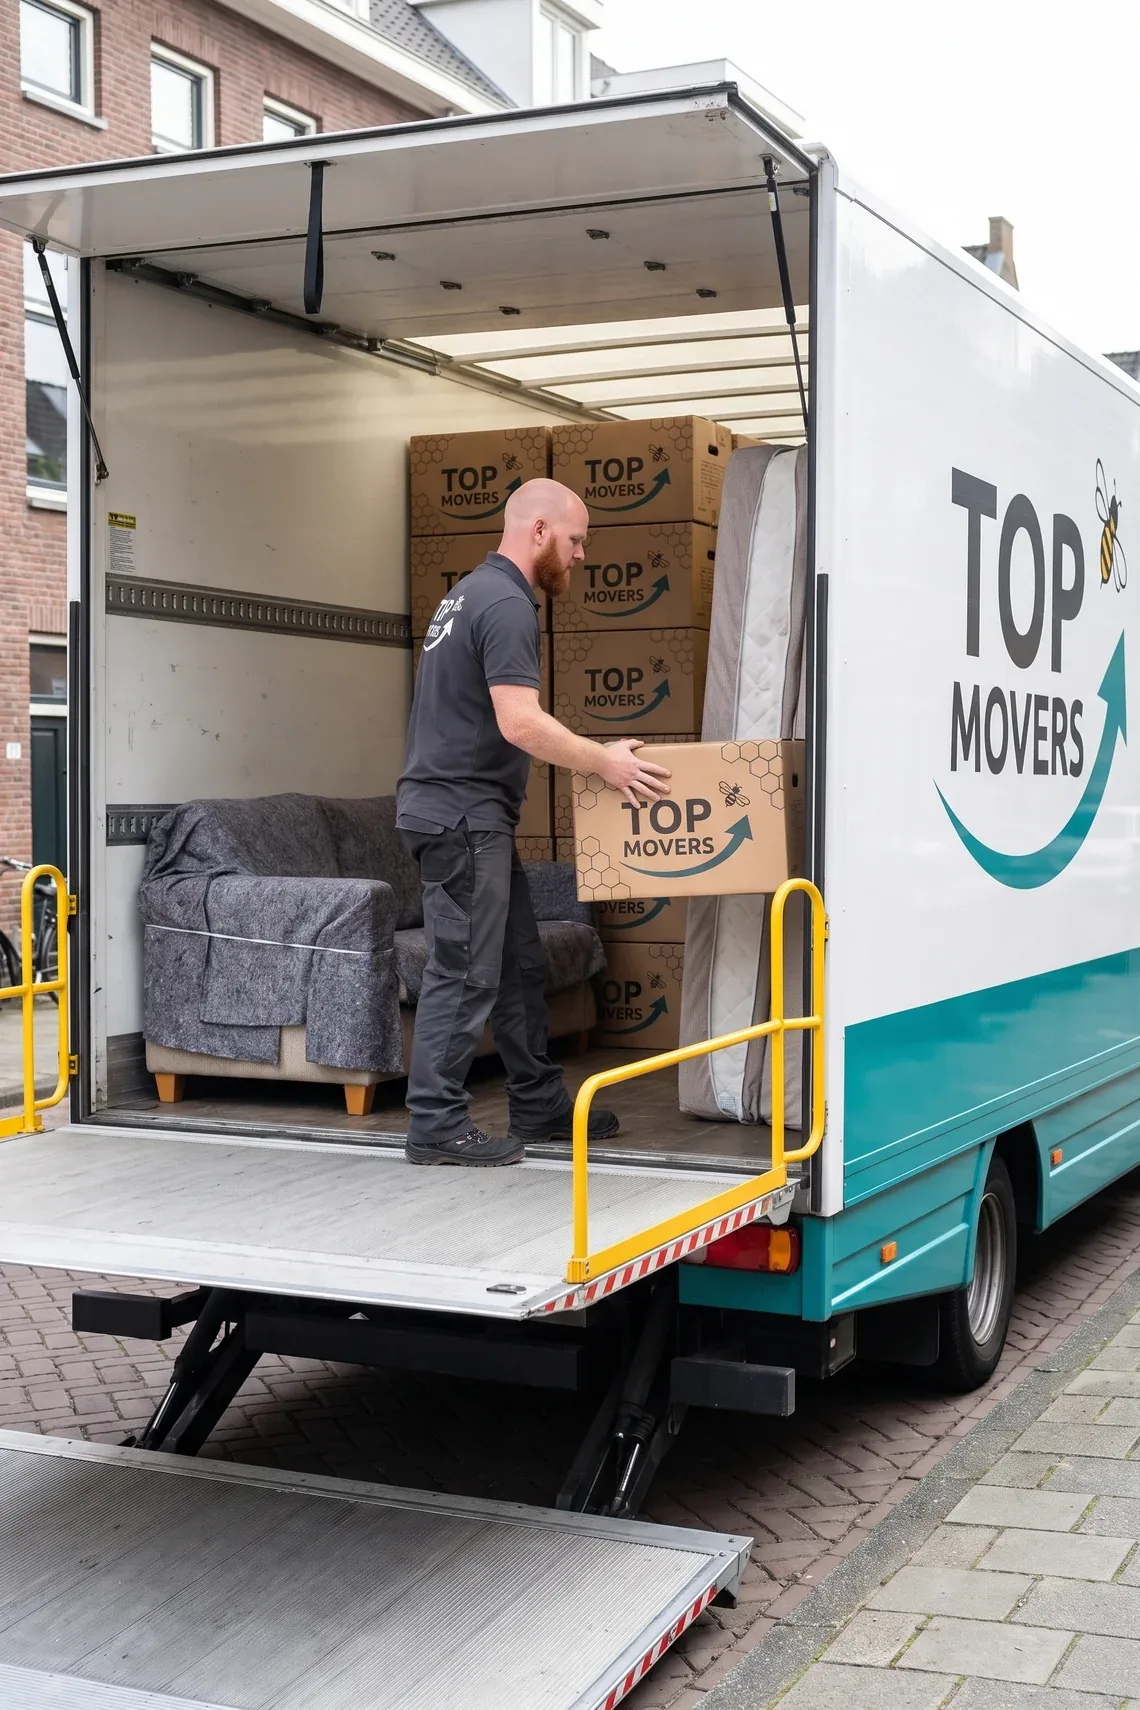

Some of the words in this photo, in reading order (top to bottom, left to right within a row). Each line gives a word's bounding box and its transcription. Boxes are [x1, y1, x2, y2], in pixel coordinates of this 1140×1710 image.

[441, 465, 498, 492] TOP
[584, 456, 644, 484] TOP
[441, 492, 499, 508] MOVERS
[584, 483, 645, 499] MOVERS
[584, 562, 643, 589] TOP
[951, 466, 1085, 674] TOP
[584, 589, 644, 604] MOVERS
[584, 667, 644, 693] TOP
[584, 693, 645, 708] MOVERS
[950, 680, 1084, 778] MOVERS
[621, 798, 712, 836] TOP
[623, 836, 715, 858] MOVERS
[599, 901, 645, 914] OVERS
[603, 980, 642, 1005] OP
[599, 1007, 643, 1021] VERS
